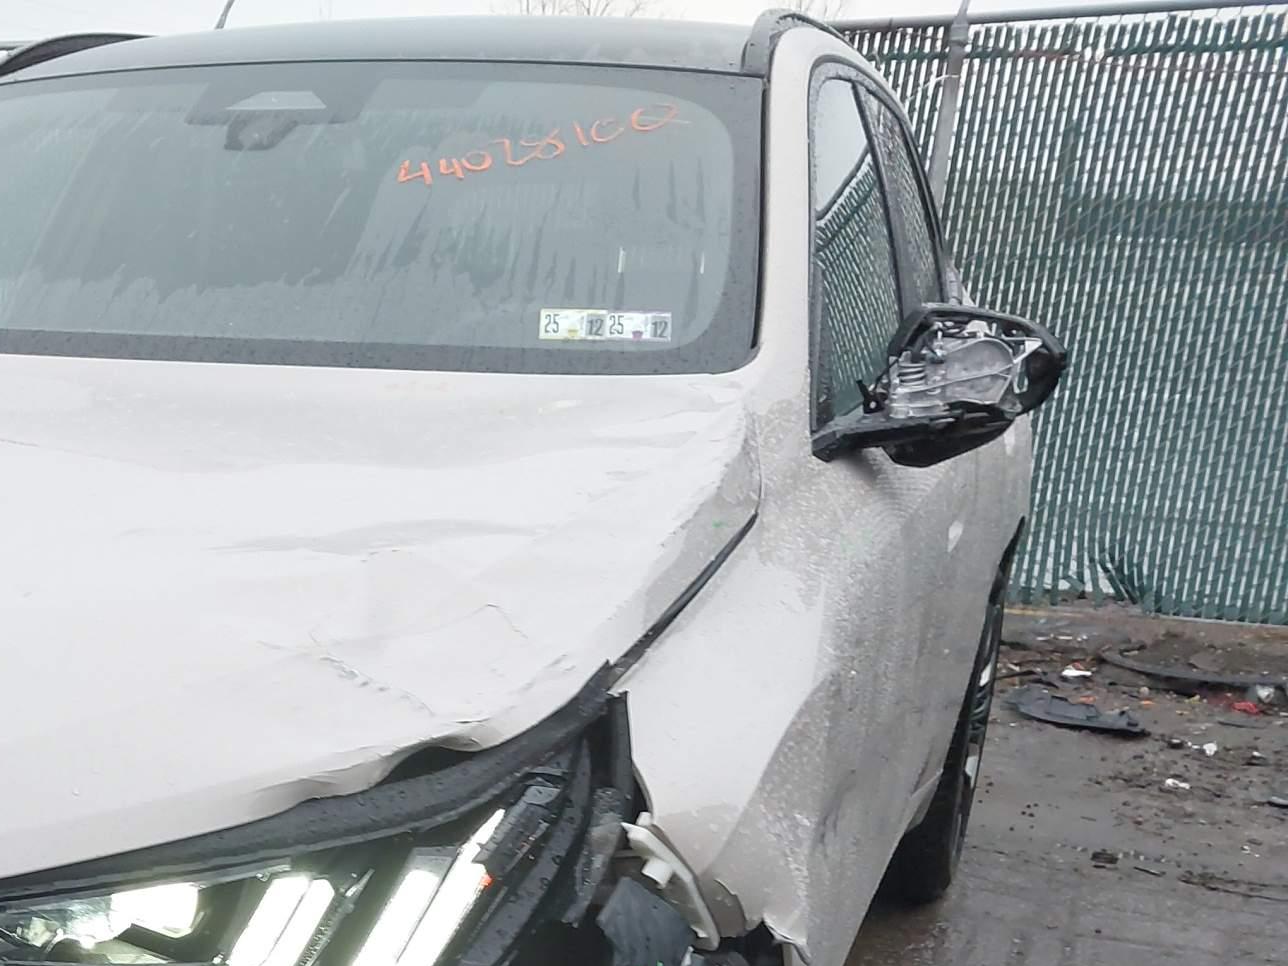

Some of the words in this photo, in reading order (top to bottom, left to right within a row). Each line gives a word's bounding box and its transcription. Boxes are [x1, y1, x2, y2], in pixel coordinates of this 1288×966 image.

[396, 103, 686, 185] 44028100
[544, 313, 560, 334] 25
[587, 318, 604, 337] 12
[609, 315, 625, 335] 25
[651, 320, 668, 338] 12
